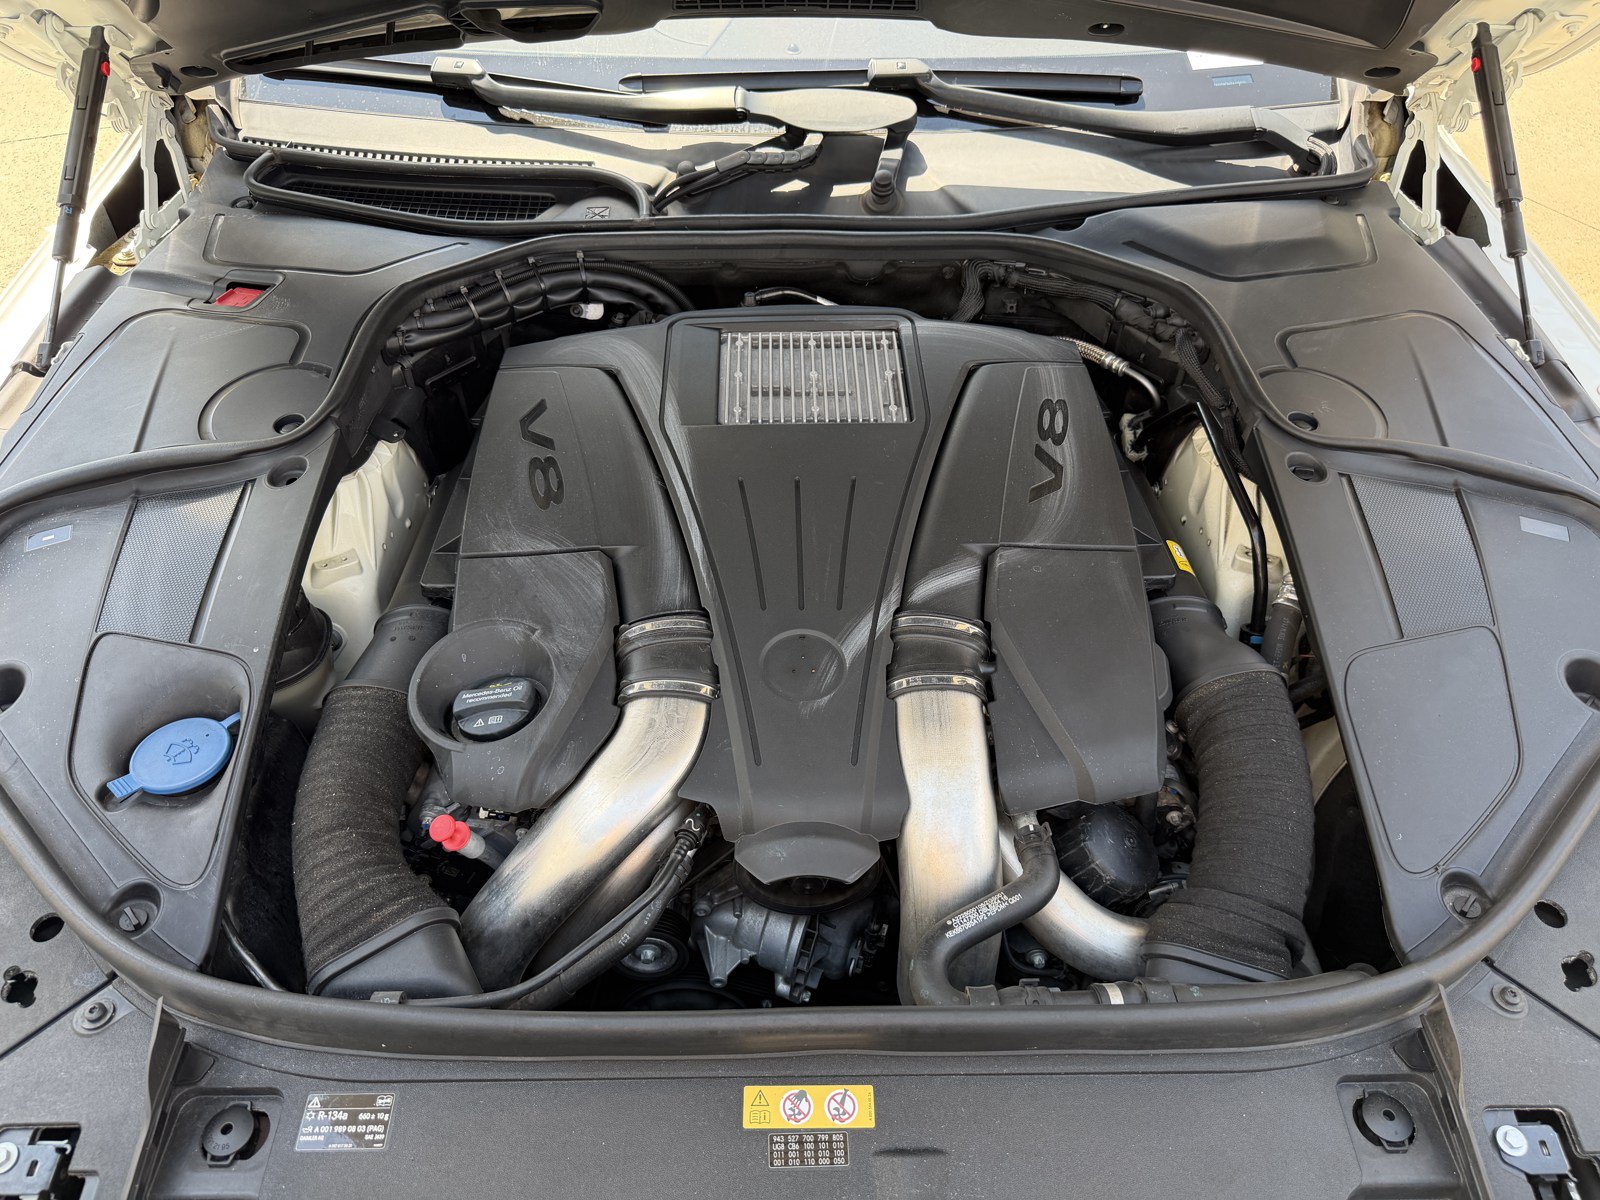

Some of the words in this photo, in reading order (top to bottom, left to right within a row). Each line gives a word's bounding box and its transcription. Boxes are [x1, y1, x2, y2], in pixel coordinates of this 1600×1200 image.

[520, 398, 564, 510] V8
[1028, 398, 1068, 503] V8
[462, 687, 512, 699] Mercedes-Benz
[466, 692, 512, 703] recommended
[318, 1110, 348, 1120] R-134a
[366, 1124, 384, 1133] (PAG)
